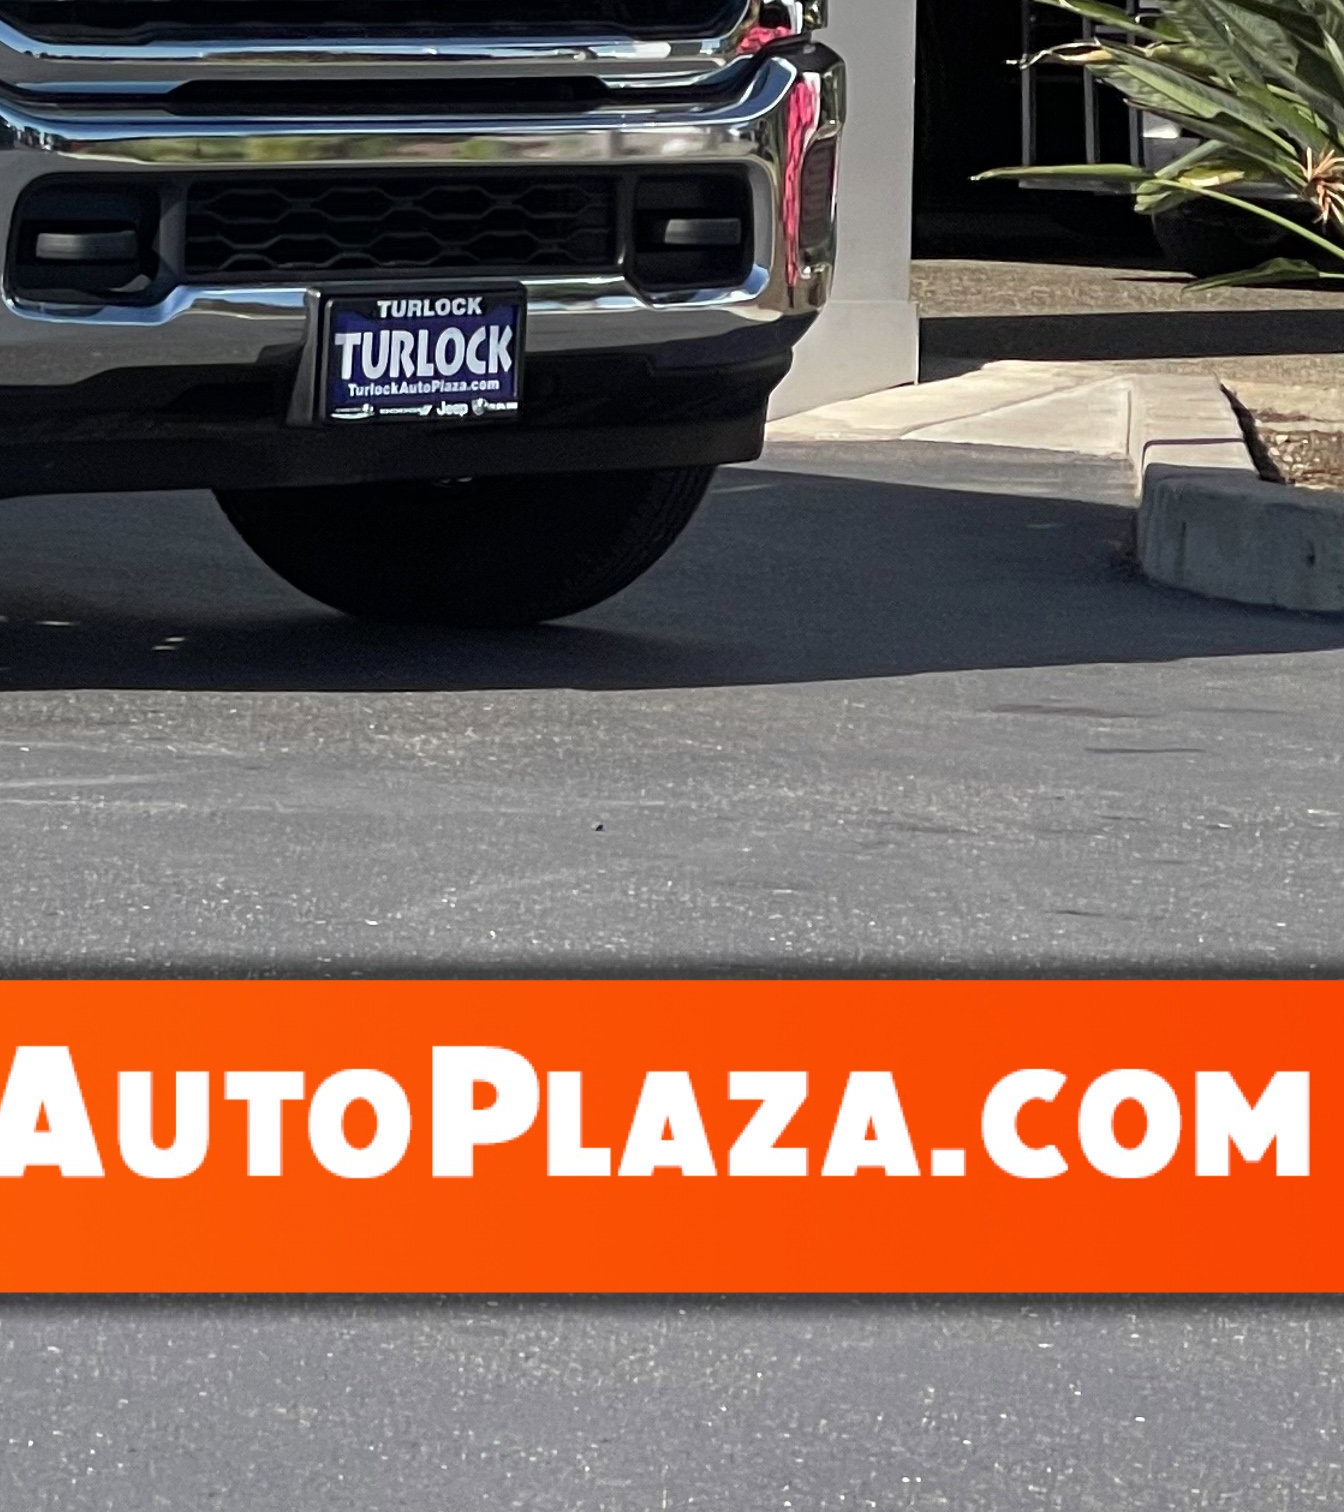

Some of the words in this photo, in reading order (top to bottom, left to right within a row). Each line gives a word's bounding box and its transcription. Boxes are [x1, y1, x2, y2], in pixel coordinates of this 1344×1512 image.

[376, 296, 484, 319] TURLOCK
[334, 324, 514, 380] TURLOCK
[347, 379, 501, 398] TurlockAutoPlaza.com
